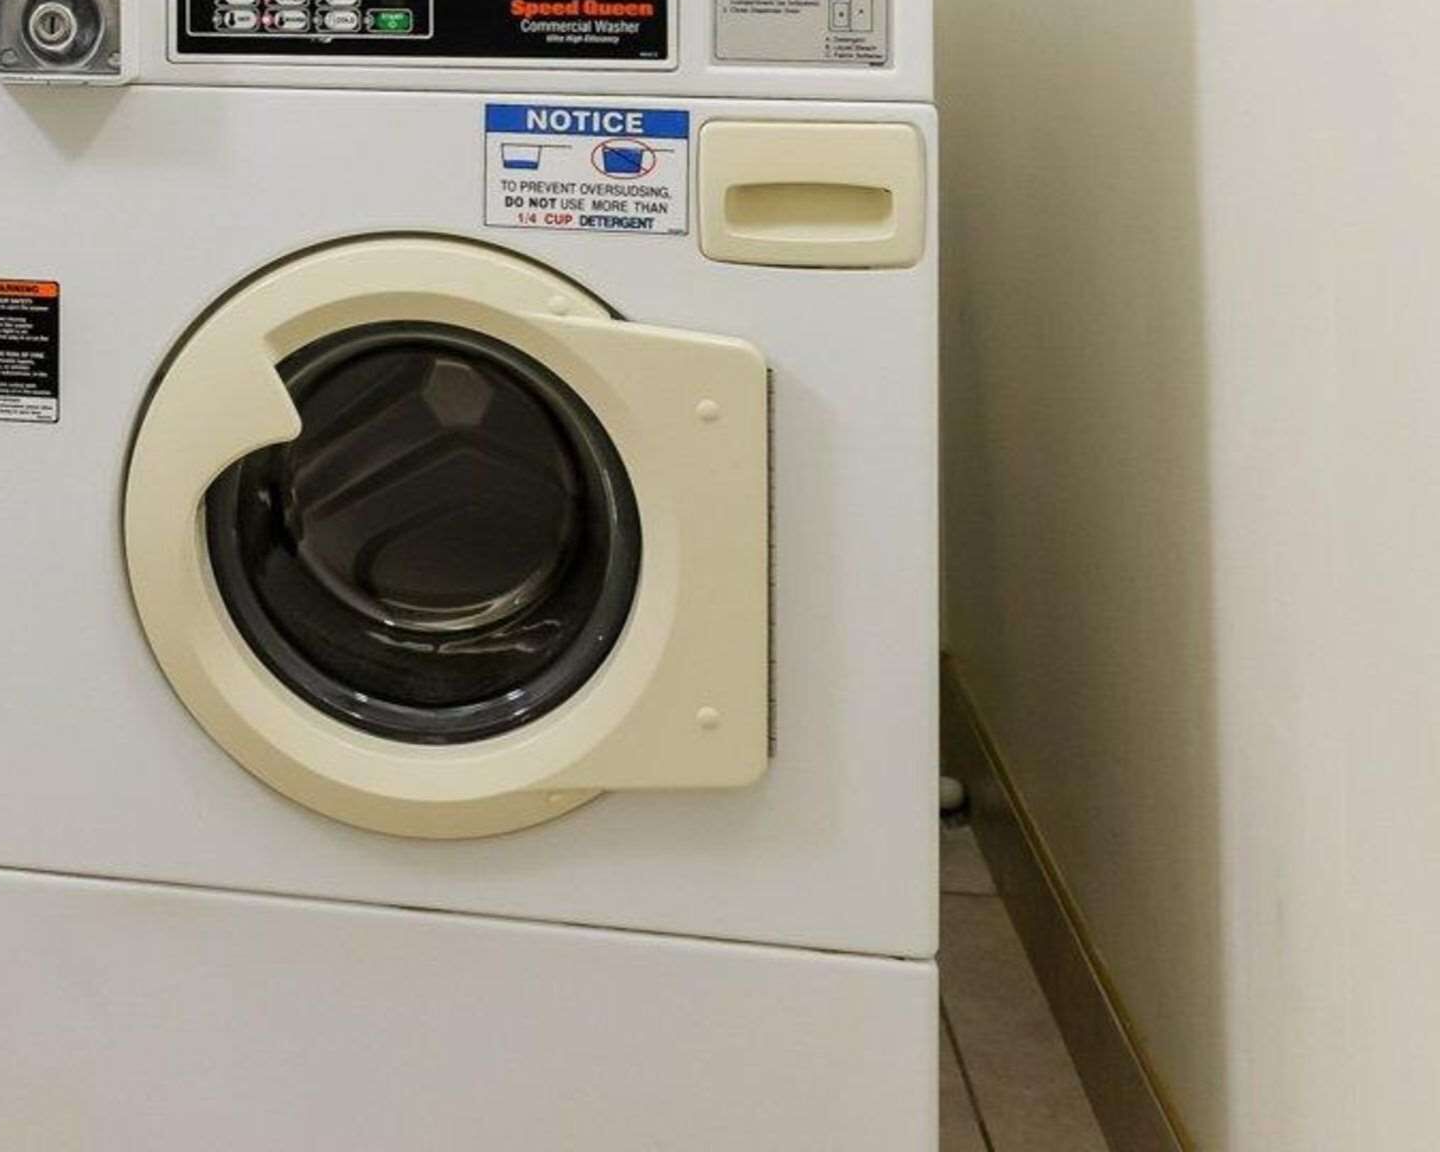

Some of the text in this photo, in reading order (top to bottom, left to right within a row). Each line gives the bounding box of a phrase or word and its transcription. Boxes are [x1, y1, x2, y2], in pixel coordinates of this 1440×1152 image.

[511, 0, 654, 20] Speed Queen
[520, 19, 640, 34] Commercial Washer
[526, 109, 644, 134] NOTICE
[501, 180, 517, 192] TO
[520, 180, 577, 195] PREVENT
[505, 196, 668, 214] DO NOT USE MORE THAN
[518, 212, 655, 230] 1/4 CUP DETERGENT
